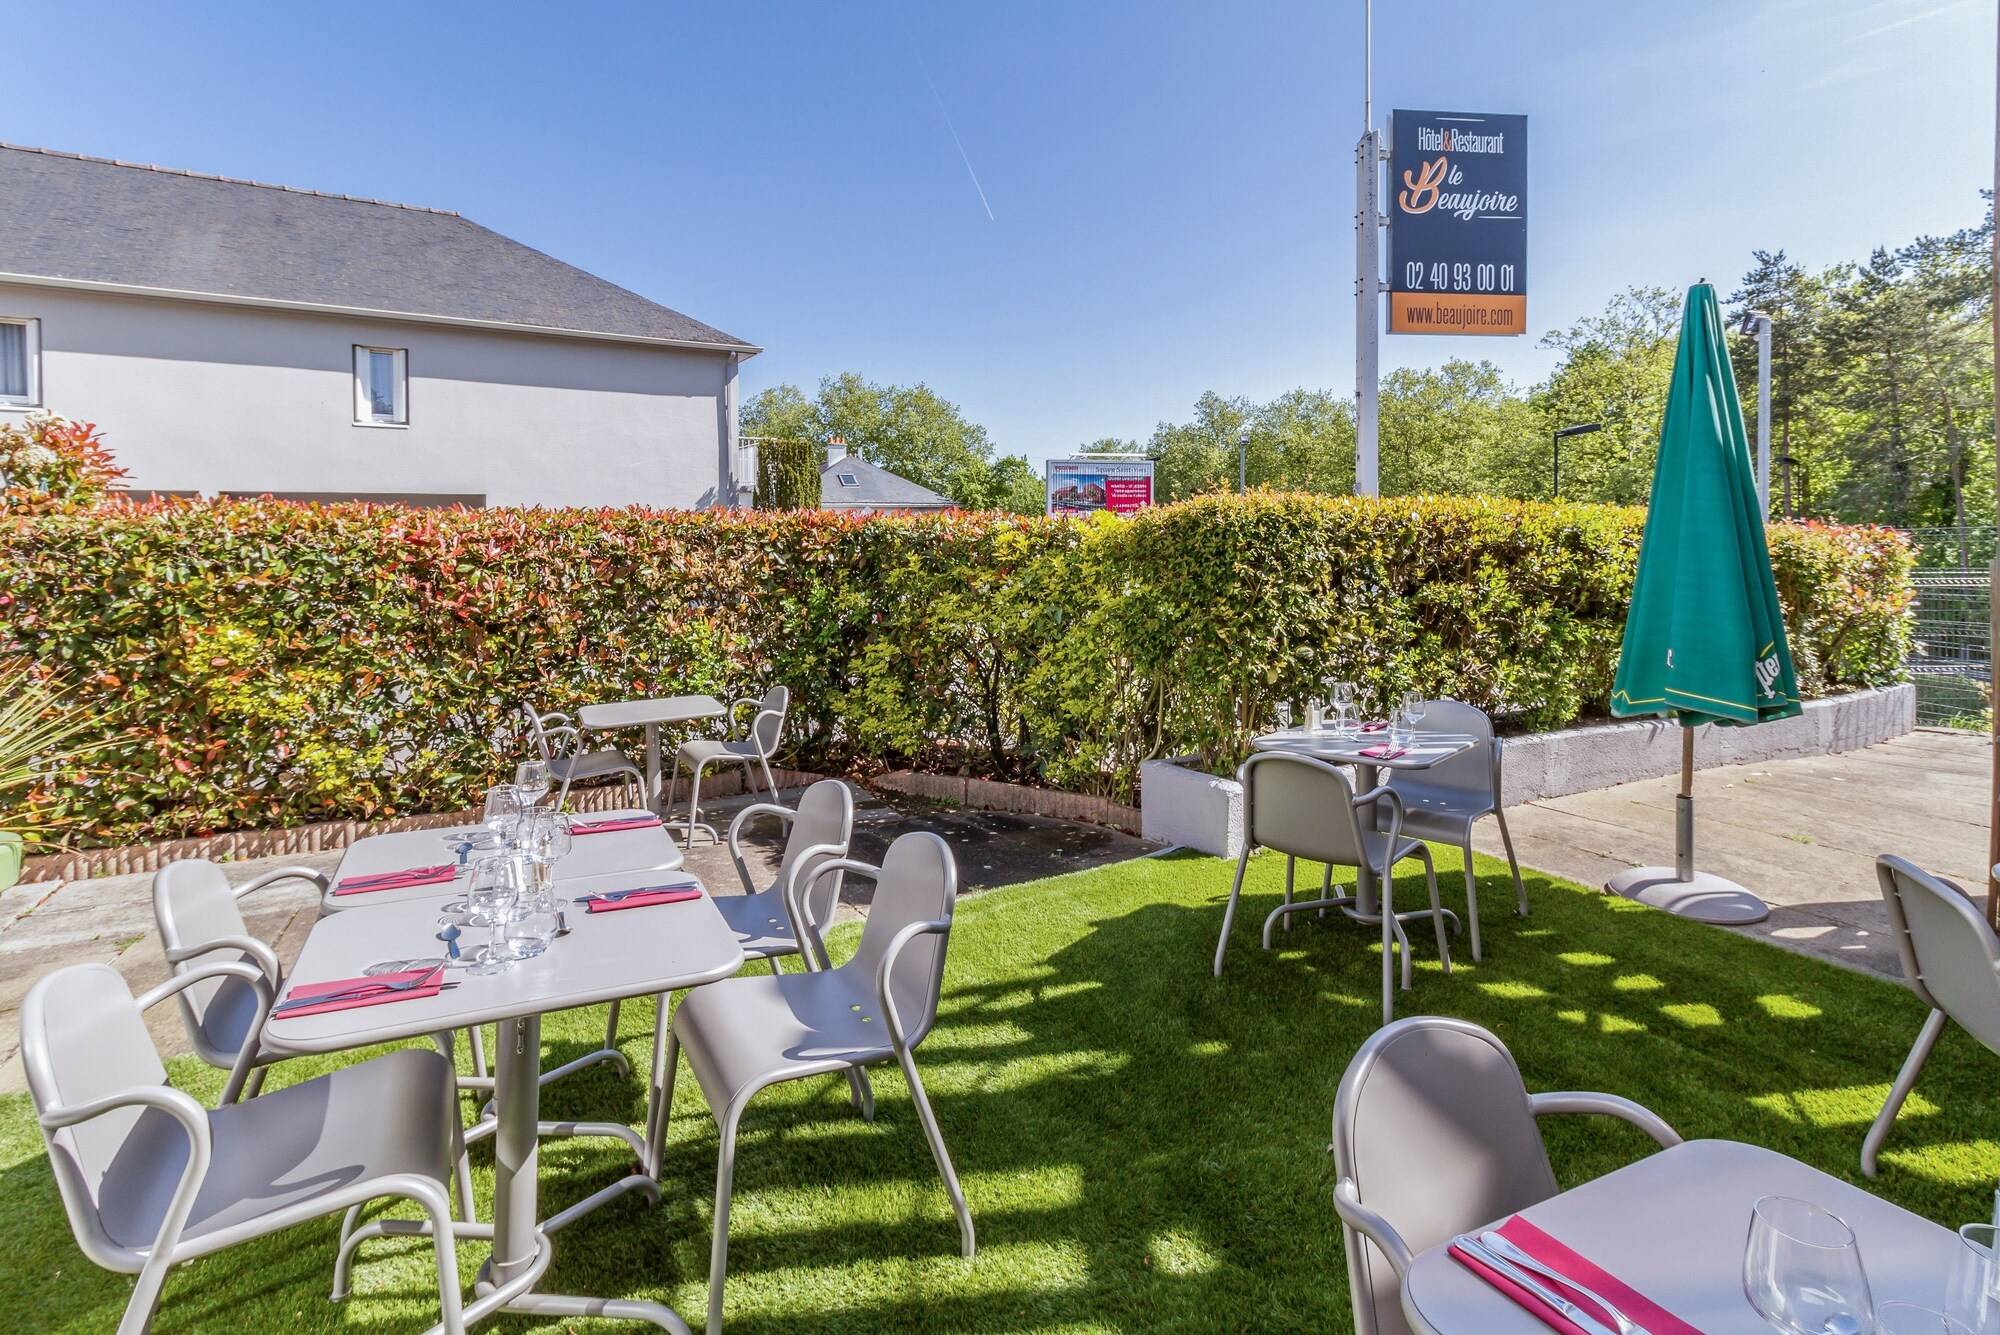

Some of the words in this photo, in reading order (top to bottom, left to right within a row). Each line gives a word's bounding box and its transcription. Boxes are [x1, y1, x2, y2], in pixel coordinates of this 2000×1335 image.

[1418, 127, 1504, 154] Hôtel&Restaurant
[1399, 156, 1518, 221] Beaujoire
[1448, 164, 1463, 185] le
[1406, 261, 1424, 290] 02
[1430, 262, 1448, 290] 40
[1453, 263, 1471, 291] 93
[1477, 264, 1495, 291] 00
[1500, 264, 1514, 292] 01
[1406, 301, 1513, 329] www.beaujoire.com
